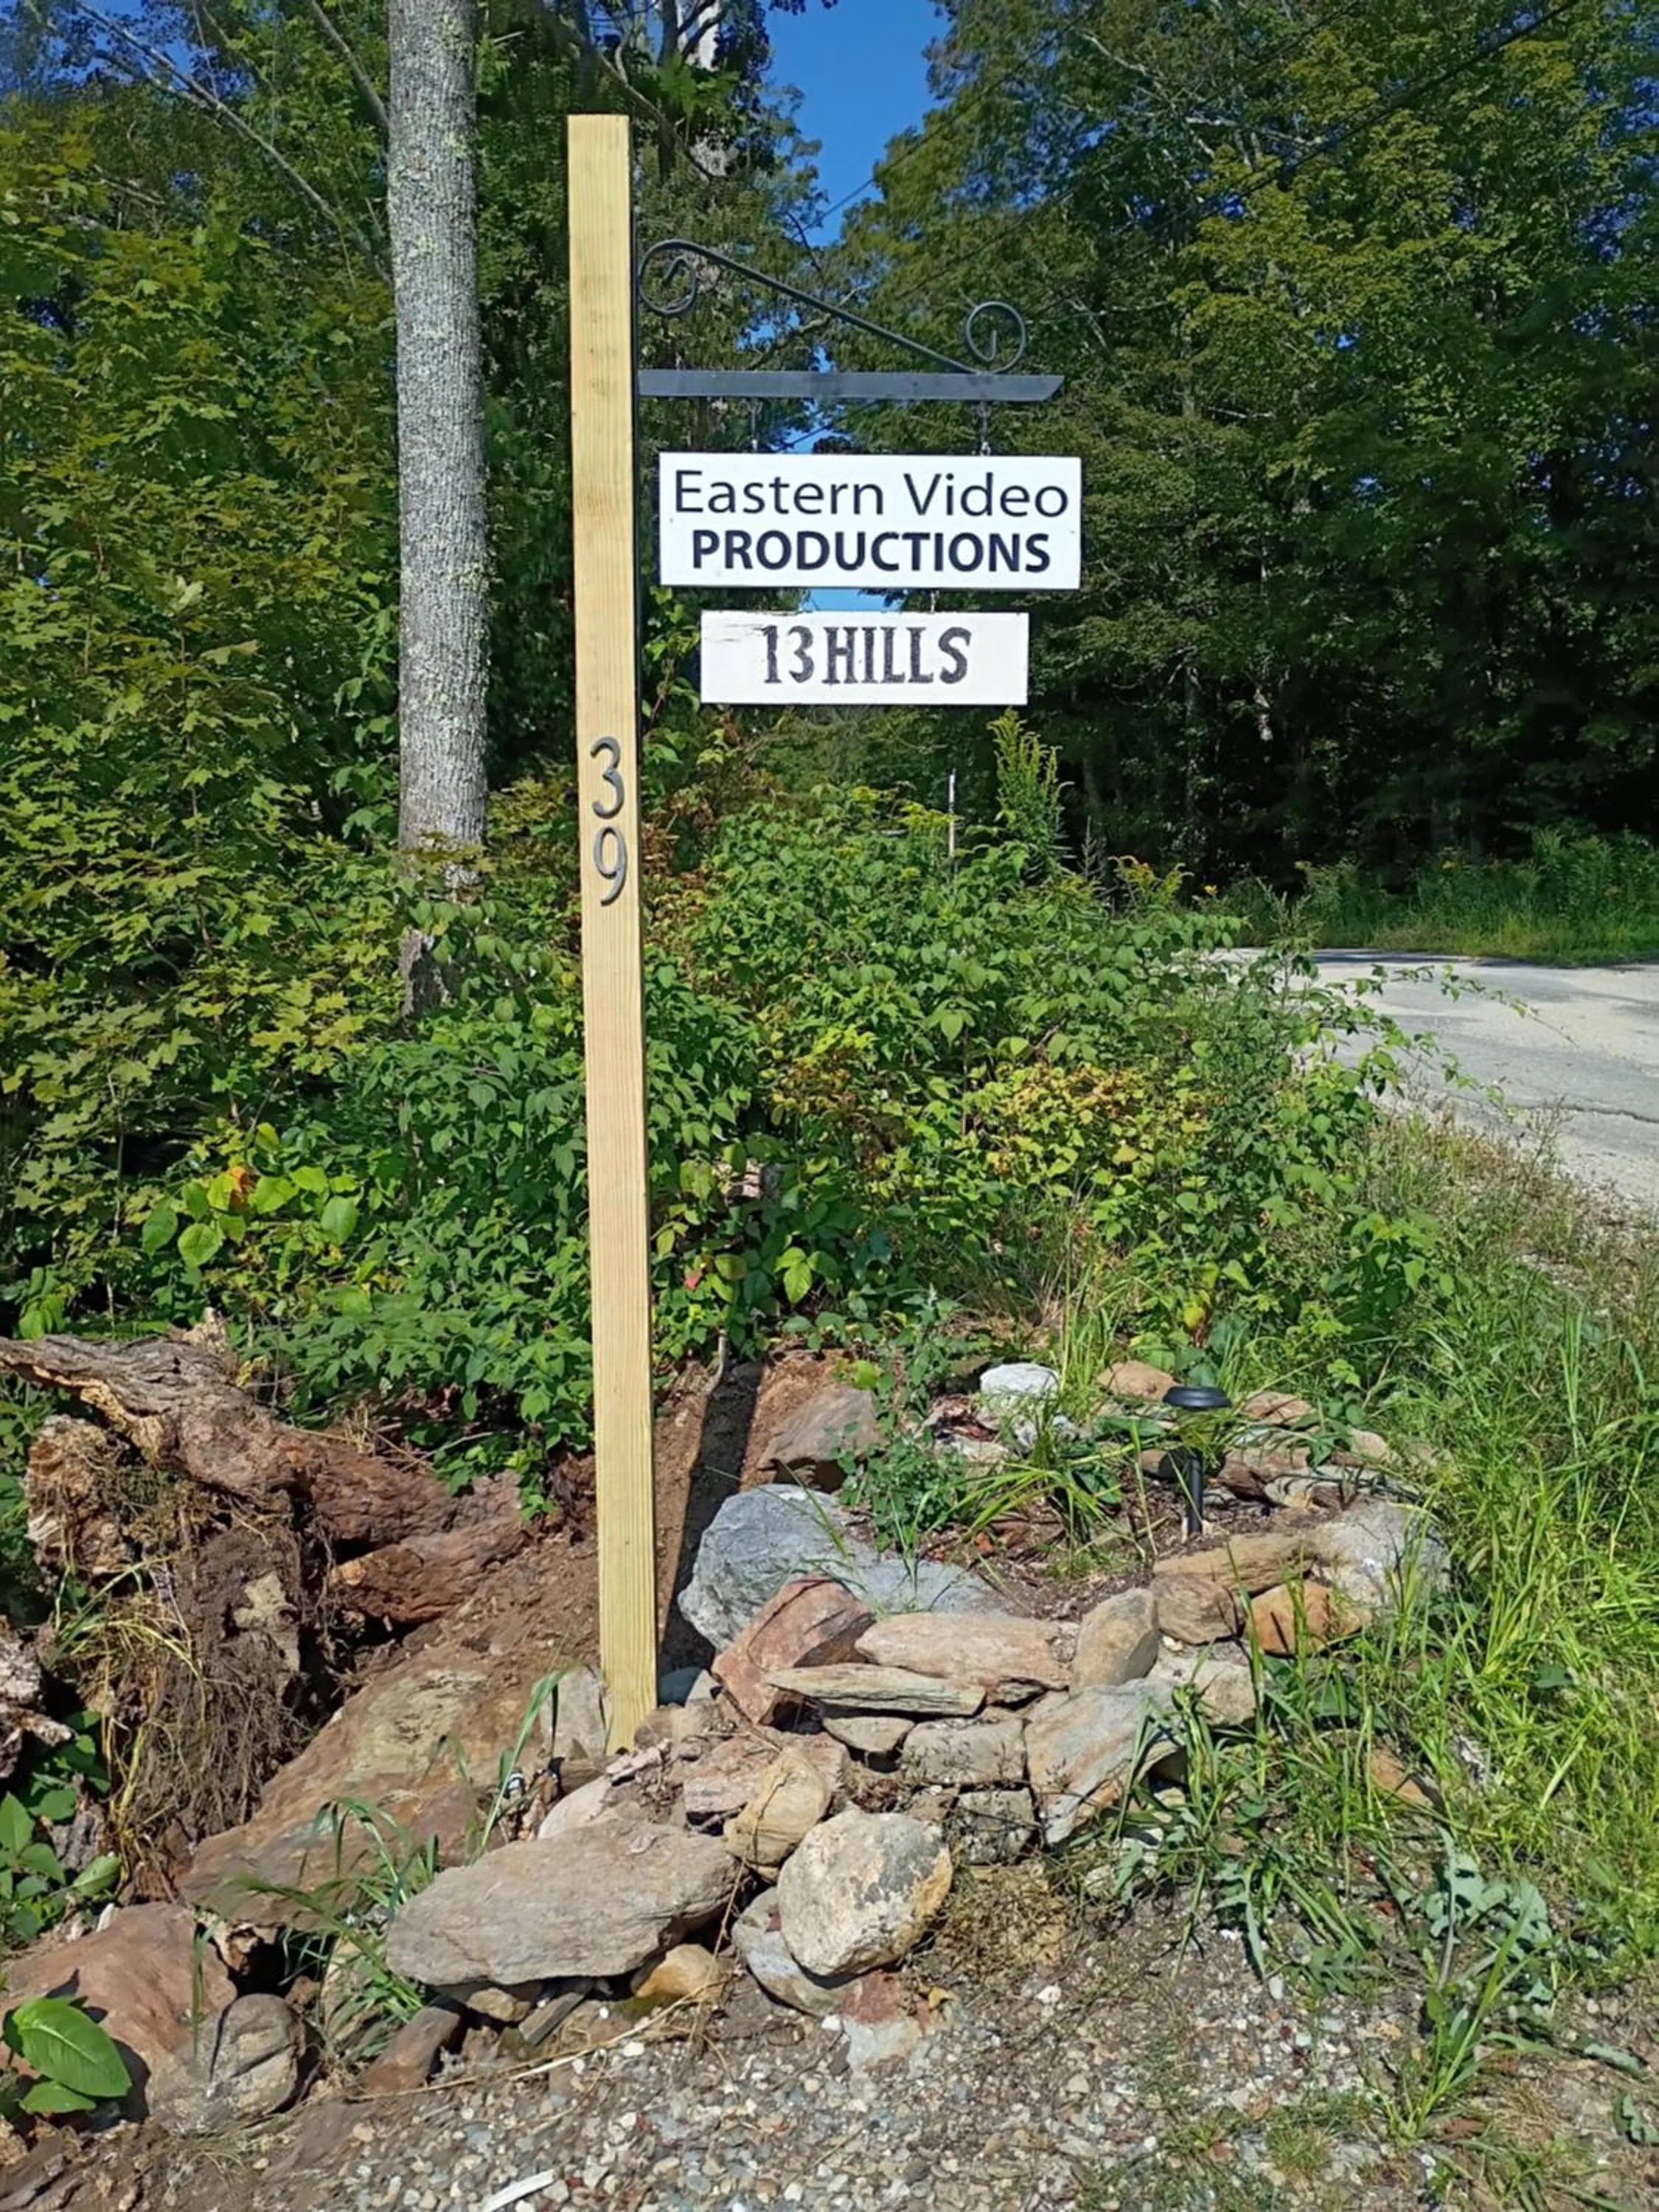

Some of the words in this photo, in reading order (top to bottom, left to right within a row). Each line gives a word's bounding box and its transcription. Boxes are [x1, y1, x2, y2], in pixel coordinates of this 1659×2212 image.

[675, 470, 883, 515] Eastern
[903, 472, 1068, 518] Video
[692, 529, 1051, 573] PRODUCTIONS
